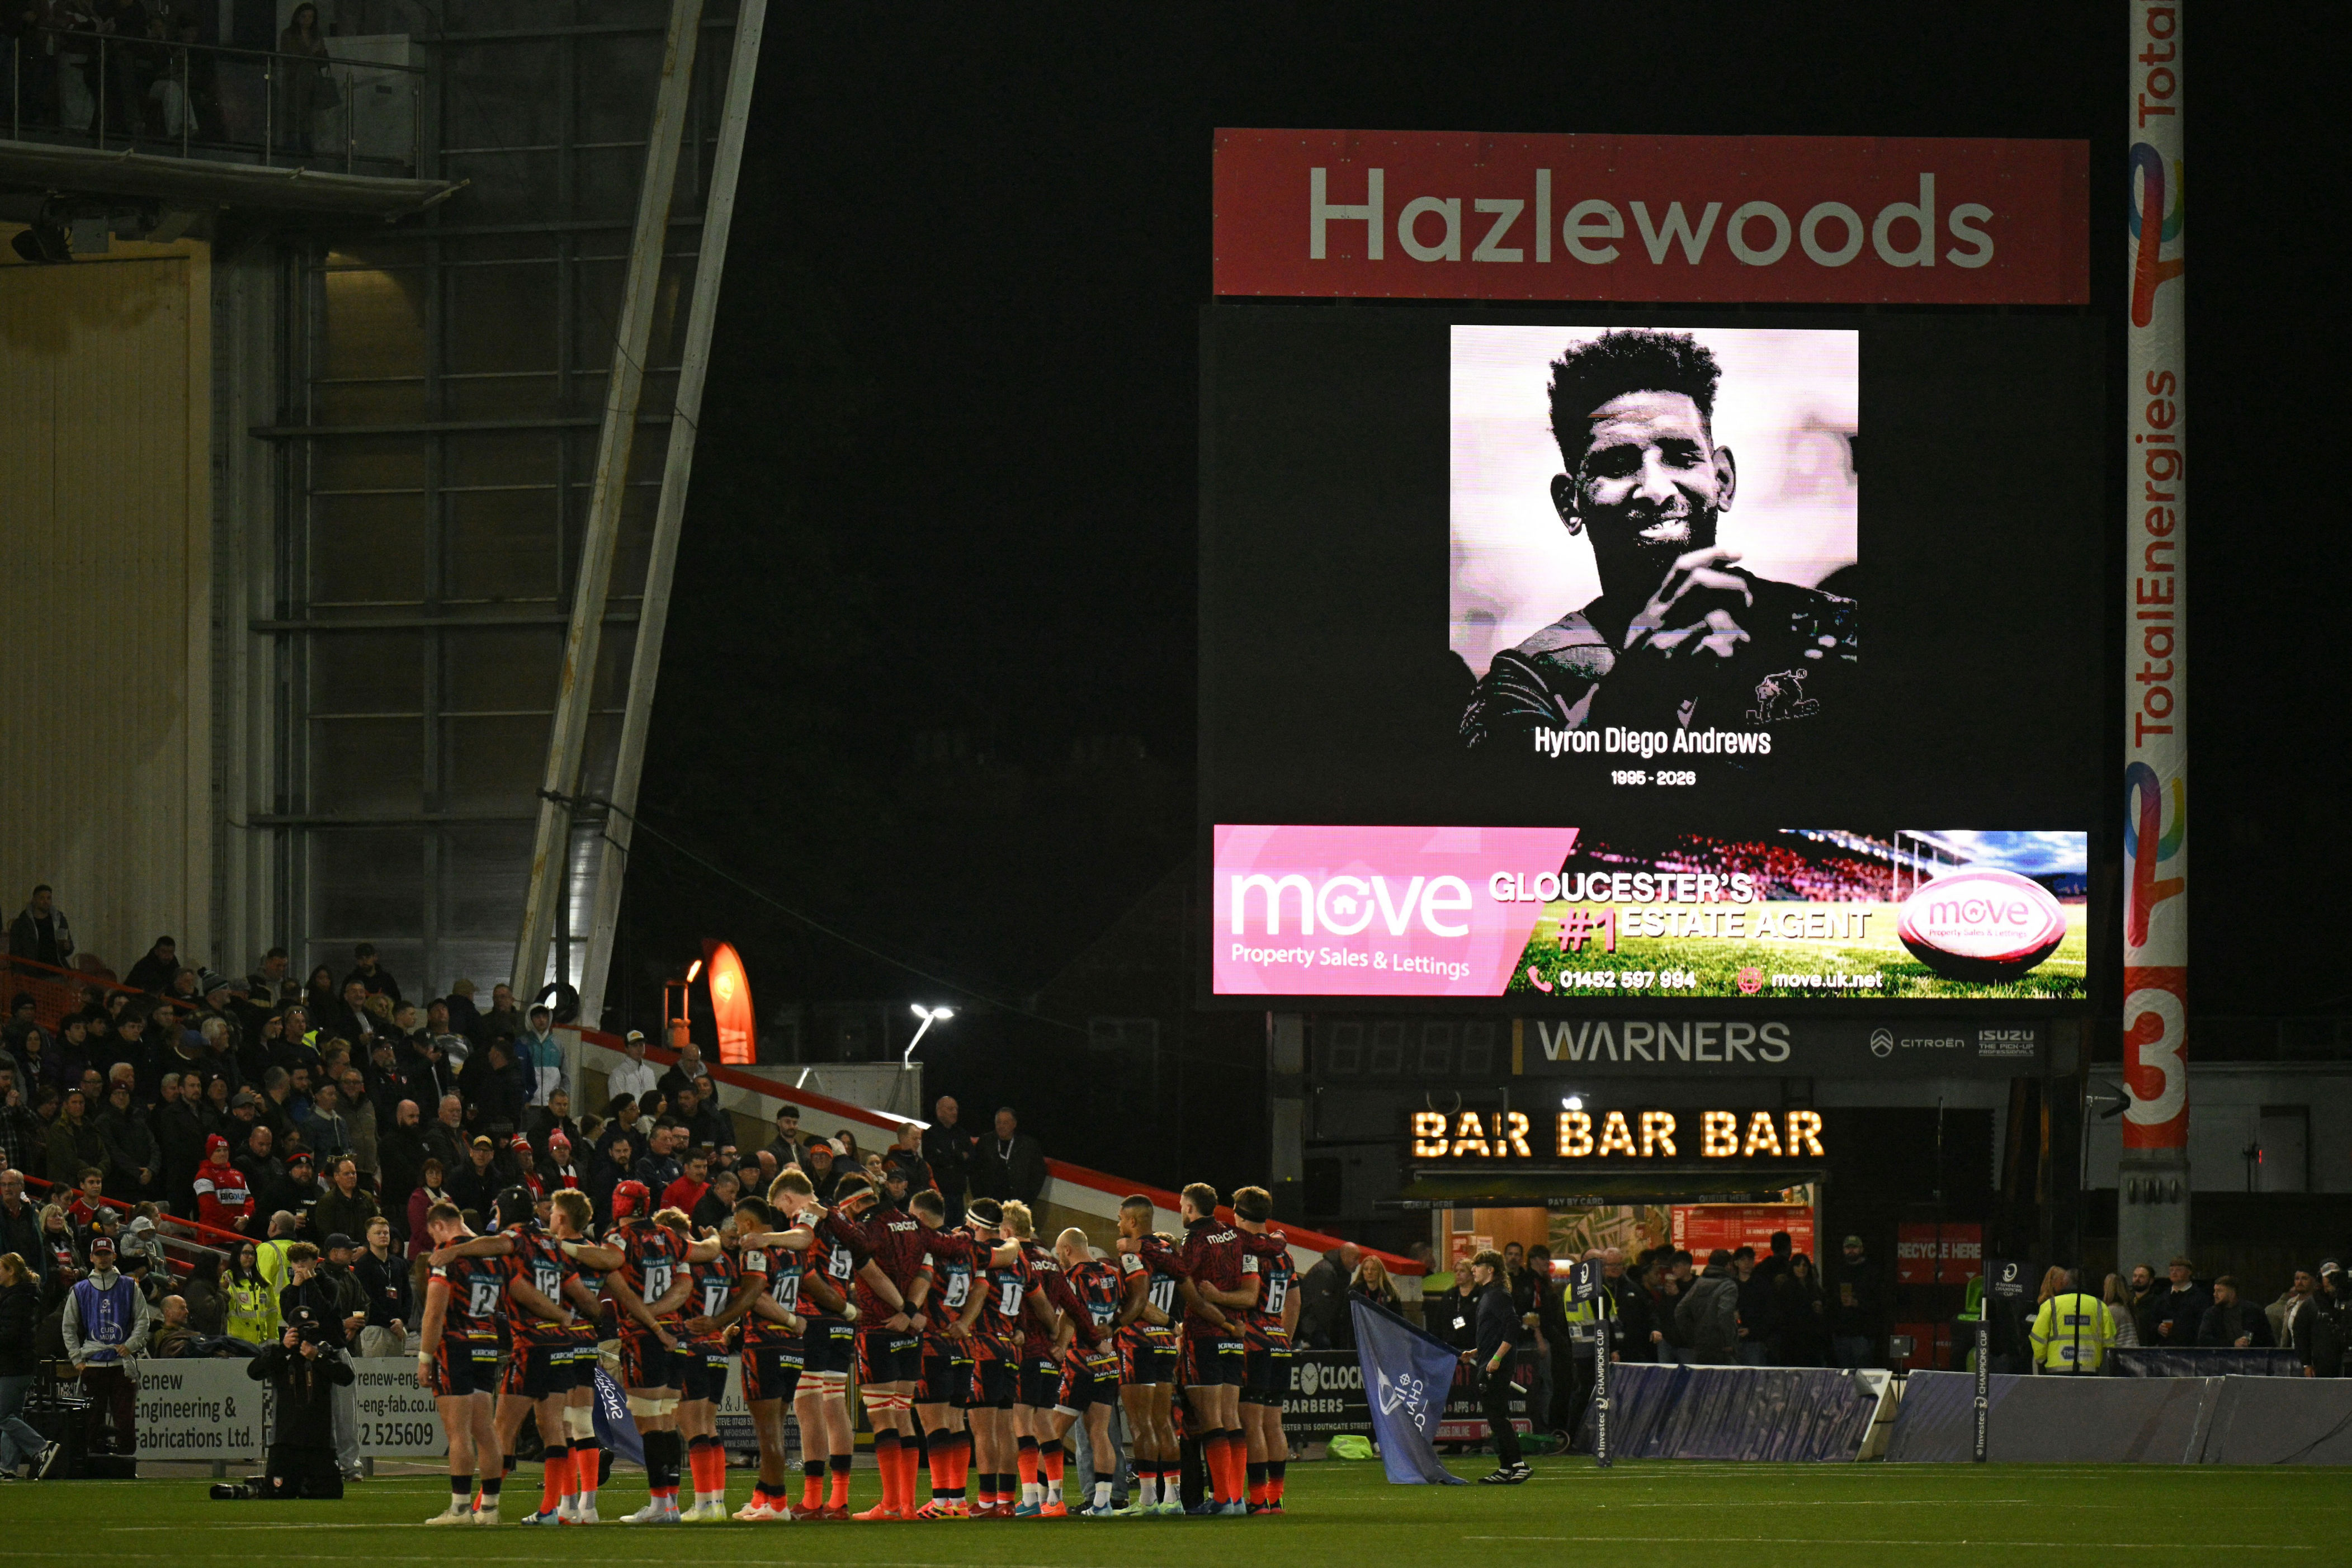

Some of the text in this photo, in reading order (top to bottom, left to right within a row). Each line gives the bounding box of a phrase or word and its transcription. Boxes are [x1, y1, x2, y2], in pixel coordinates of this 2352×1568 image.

[2138, 0, 2176, 127] Tota
[1310, 167, 1995, 268] Hazlewoods
[2135, 369, 2183, 748] TotalEnergies
[1535, 727, 1771, 758] Hyron Diego Andrews
[1611, 771, 1646, 785] 1995
[1656, 771, 1697, 785] 2026
[1489, 871, 1754, 903] GLOUCESTER'S
[1231, 873, 1472, 937] move
[1929, 899, 2029, 925] move
[1556, 906, 1872, 953] #1 ESTATE AGENT
[1929, 929, 1961, 937] Property
[1995, 929, 2027, 938] Lettings
[1232, 943, 1470, 980] Property Sales & Lettings
[1560, 970, 1697, 989] 01452 597 994
[1772, 971, 1883, 988] move.uk.net
[1537, 1021, 1790, 1062] WARNERS
[1978, 1030, 2034, 1041] ISUZU
[2124, 988, 2185, 1125] 3
[1411, 1110, 1825, 1158] BAR BAR BAR
[1548, 1198, 1565, 1206] PAY
[1580, 1197, 1604, 1206] CARD
[1897, 1242, 1981, 1258] RECYCE HERE
[539, 1270, 559, 1303] 12
[651, 1268, 666, 1301] 8
[776, 1277, 795, 1310] 14
[1272, 1281, 1285, 1312] 6
[475, 1285, 495, 1315] 2
[712, 1287, 724, 1317] 7
[358, 1372, 419, 1390] renew-eng
[135, 1396, 236, 1423] Engineering &
[357, 1395, 438, 1416] -eng-fab.co.u
[725, 1396, 732, 1411] &
[735, 1396, 740, 1411] J
[1282, 1399, 1343, 1414] BARBERS
[1454, 1401, 1468, 1413] APPS
[135, 1426, 254, 1448] Fabrications Ltd.
[358, 1423, 433, 1446] 2 525609
[1451, 1426, 1470, 1437] ONLINE
